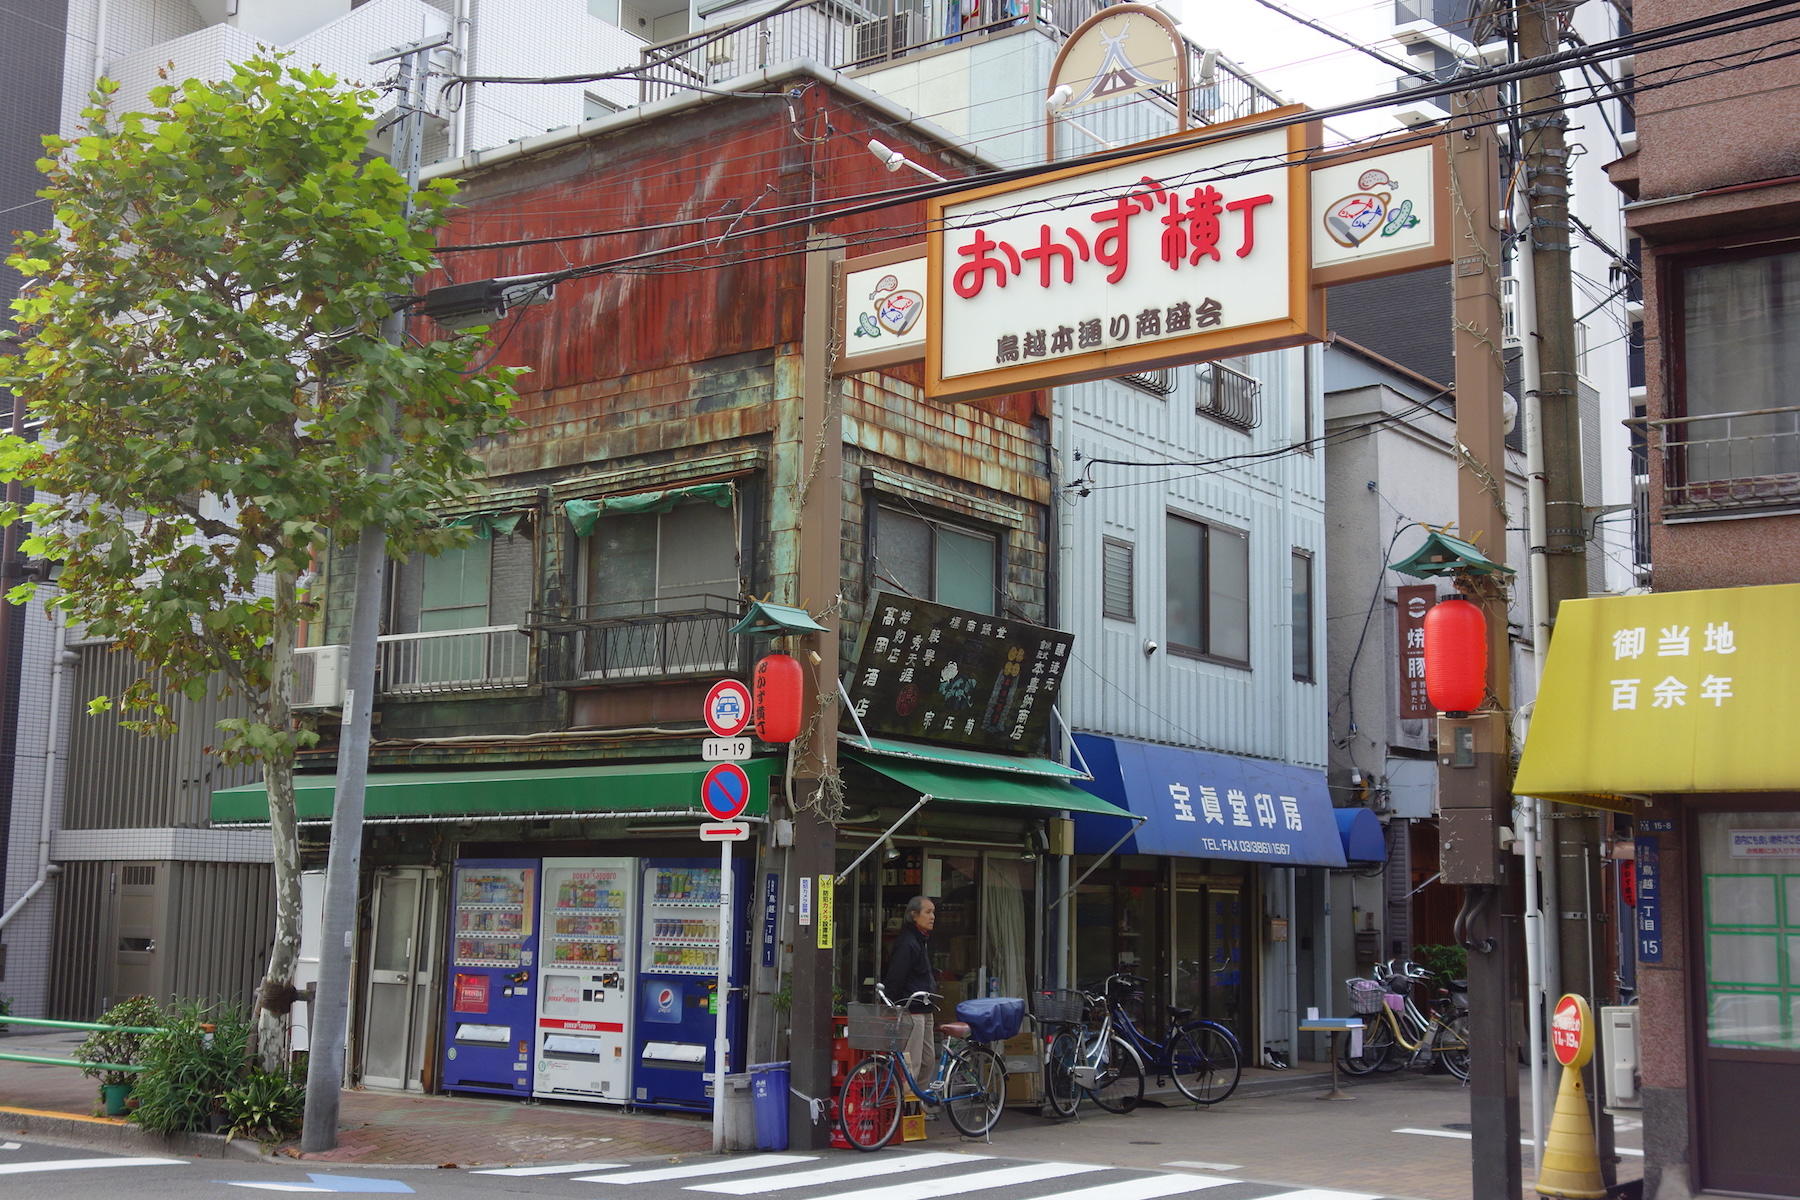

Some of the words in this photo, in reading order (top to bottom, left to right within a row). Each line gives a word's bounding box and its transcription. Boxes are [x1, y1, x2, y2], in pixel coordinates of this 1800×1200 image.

[952, 176, 1273, 299] おかず横丁
[996, 297, 1223, 364] 鳥越本通り商盛会
[1612, 621, 1737, 661] 御当地
[1610, 673, 1733, 711] 百余年
[1642, 865, 1655, 931] 鳥越一丁目
[1642, 940, 1658, 954] 15
